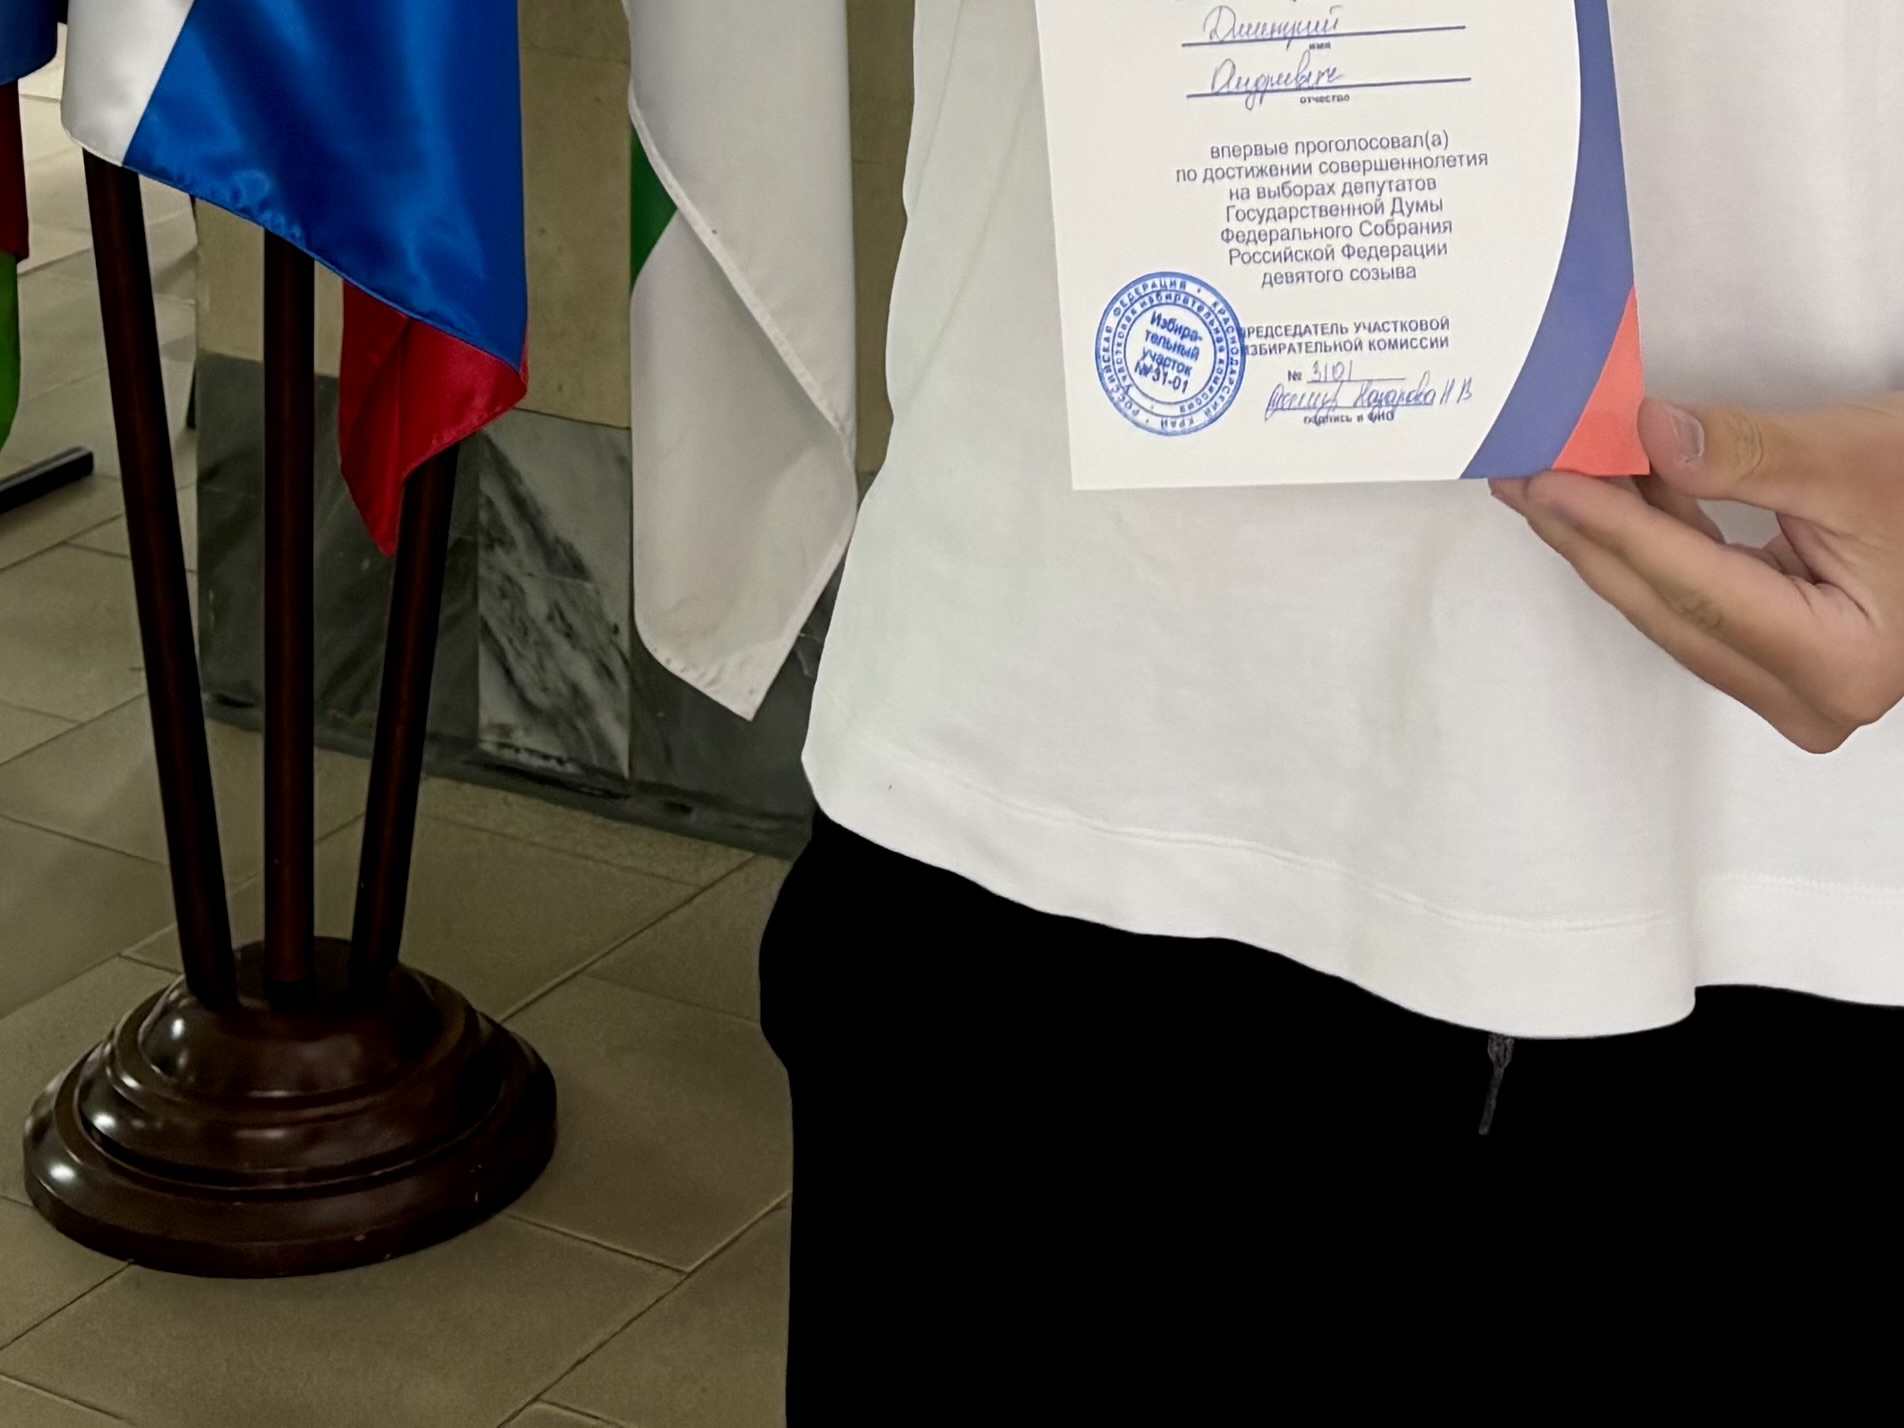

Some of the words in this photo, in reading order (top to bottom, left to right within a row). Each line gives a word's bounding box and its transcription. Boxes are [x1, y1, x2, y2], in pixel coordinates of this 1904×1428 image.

[1309, 41, 1331, 50] имя
[1300, 93, 1350, 105] отчество
[1210, 144, 1289, 160] впервые
[1295, 129, 1449, 158] проголосовал(а)
[1176, 168, 1197, 182] по
[1202, 163, 1313, 184] достижении
[1318, 152, 1489, 176] совершеннолетия
[1229, 187, 1251, 201] на
[1256, 180, 1336, 201] выборах
[1341, 176, 1437, 197] депутатов
[1225, 198, 1385, 225] Государственной
[1390, 196, 1444, 217] Думы
[1220, 221, 1353, 246] Федерального
[1358, 219, 1453, 239] Собрания
[1228, 243, 1335, 266] Российской
[1341, 241, 1448, 263] Федерации
[1261, 268, 1344, 289] девятого
[1349, 265, 1417, 282] созыва
[1150, 310, 1203, 342] Избира-
[1353, 315, 1450, 333] УЧАСТКОВОЙ
[1144, 329, 1201, 362] тельный
[1368, 335, 1450, 352] КОМИССИИ
[1141, 347, 1193, 378] участок
